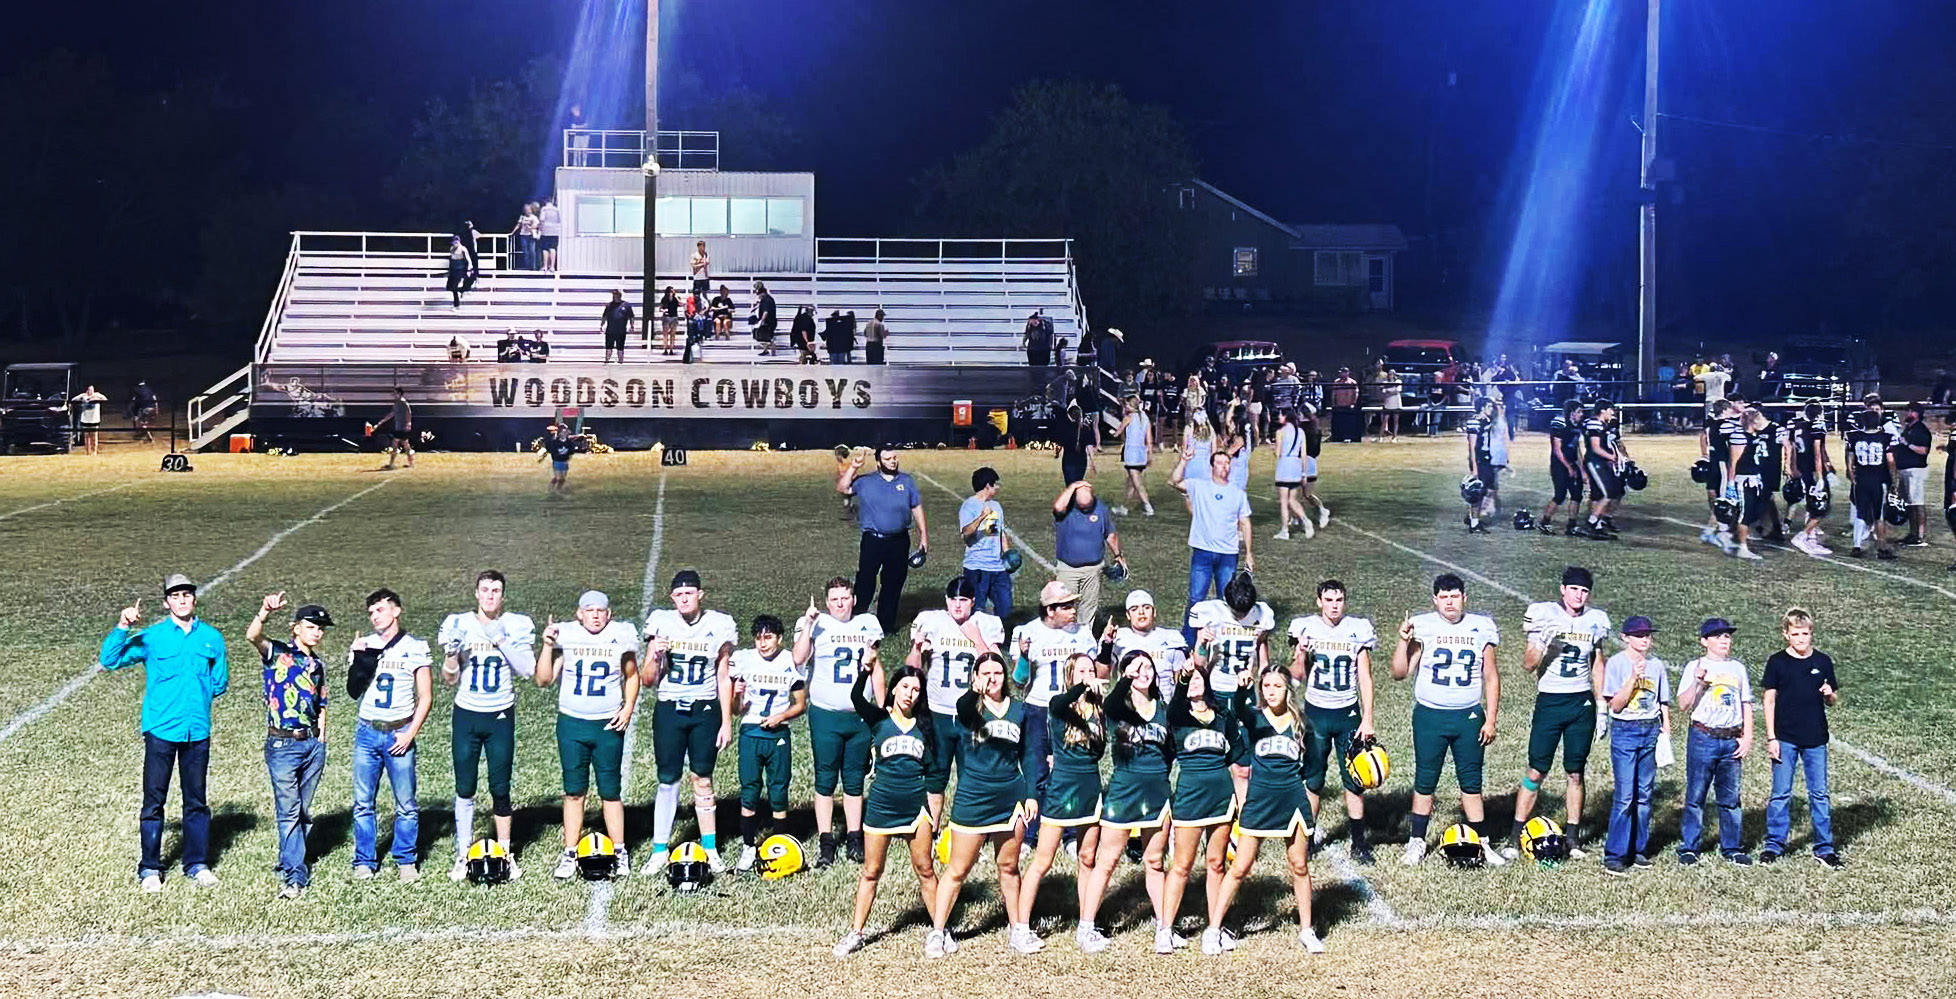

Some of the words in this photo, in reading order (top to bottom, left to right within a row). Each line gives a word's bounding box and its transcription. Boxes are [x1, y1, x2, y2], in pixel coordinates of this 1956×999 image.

[490, 377, 674, 408] WOODSON
[691, 377, 872, 409] COWBOYS
[164, 456, 184, 472] 30
[665, 449, 685, 465] 40
[572, 647, 614, 658] GUTHRIE
[669, 640, 709, 652] GUTHRIE
[1219, 639, 1254, 675] 15
[1314, 640, 1352, 652] GUTHRIE
[1436, 635, 1476, 647] GUTHRIE
[469, 655, 503, 693] 10
[573, 658, 611, 697] 12
[667, 652, 709, 686] 50
[833, 646, 865, 684] 21
[940, 650, 976, 689] 13
[1312, 652, 1353, 692] 20
[1431, 647, 1477, 687] 23
[1560, 643, 1582, 678] 2
[374, 672, 395, 709] 9
[759, 688, 778, 719] 7
